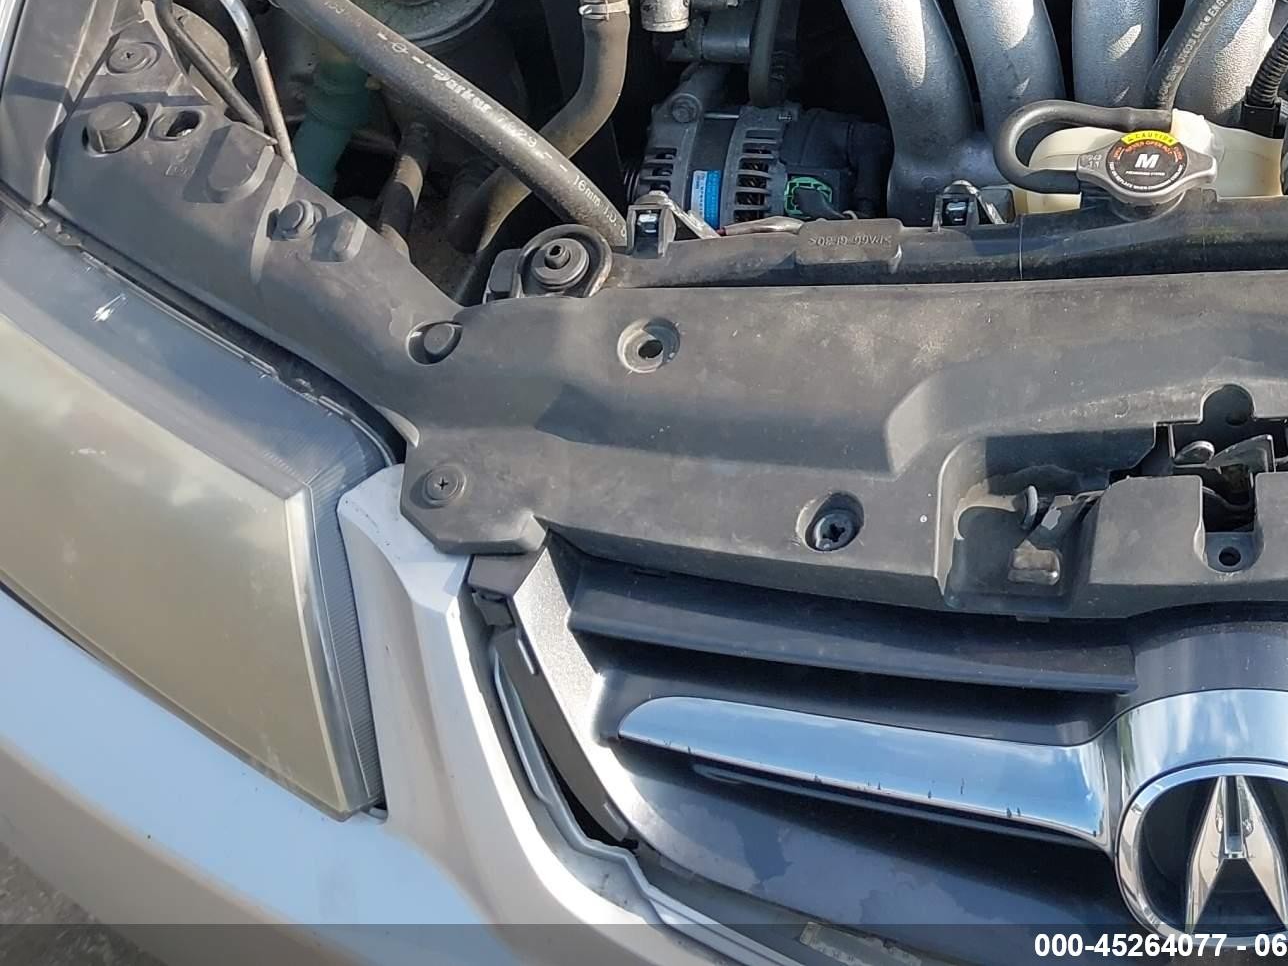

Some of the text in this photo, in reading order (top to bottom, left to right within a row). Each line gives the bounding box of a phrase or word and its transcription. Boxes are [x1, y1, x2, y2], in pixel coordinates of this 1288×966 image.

[1135, 132, 1175, 143] CAUTION
[1134, 153, 1160, 169] M
[573, 174, 602, 207] 16mm
